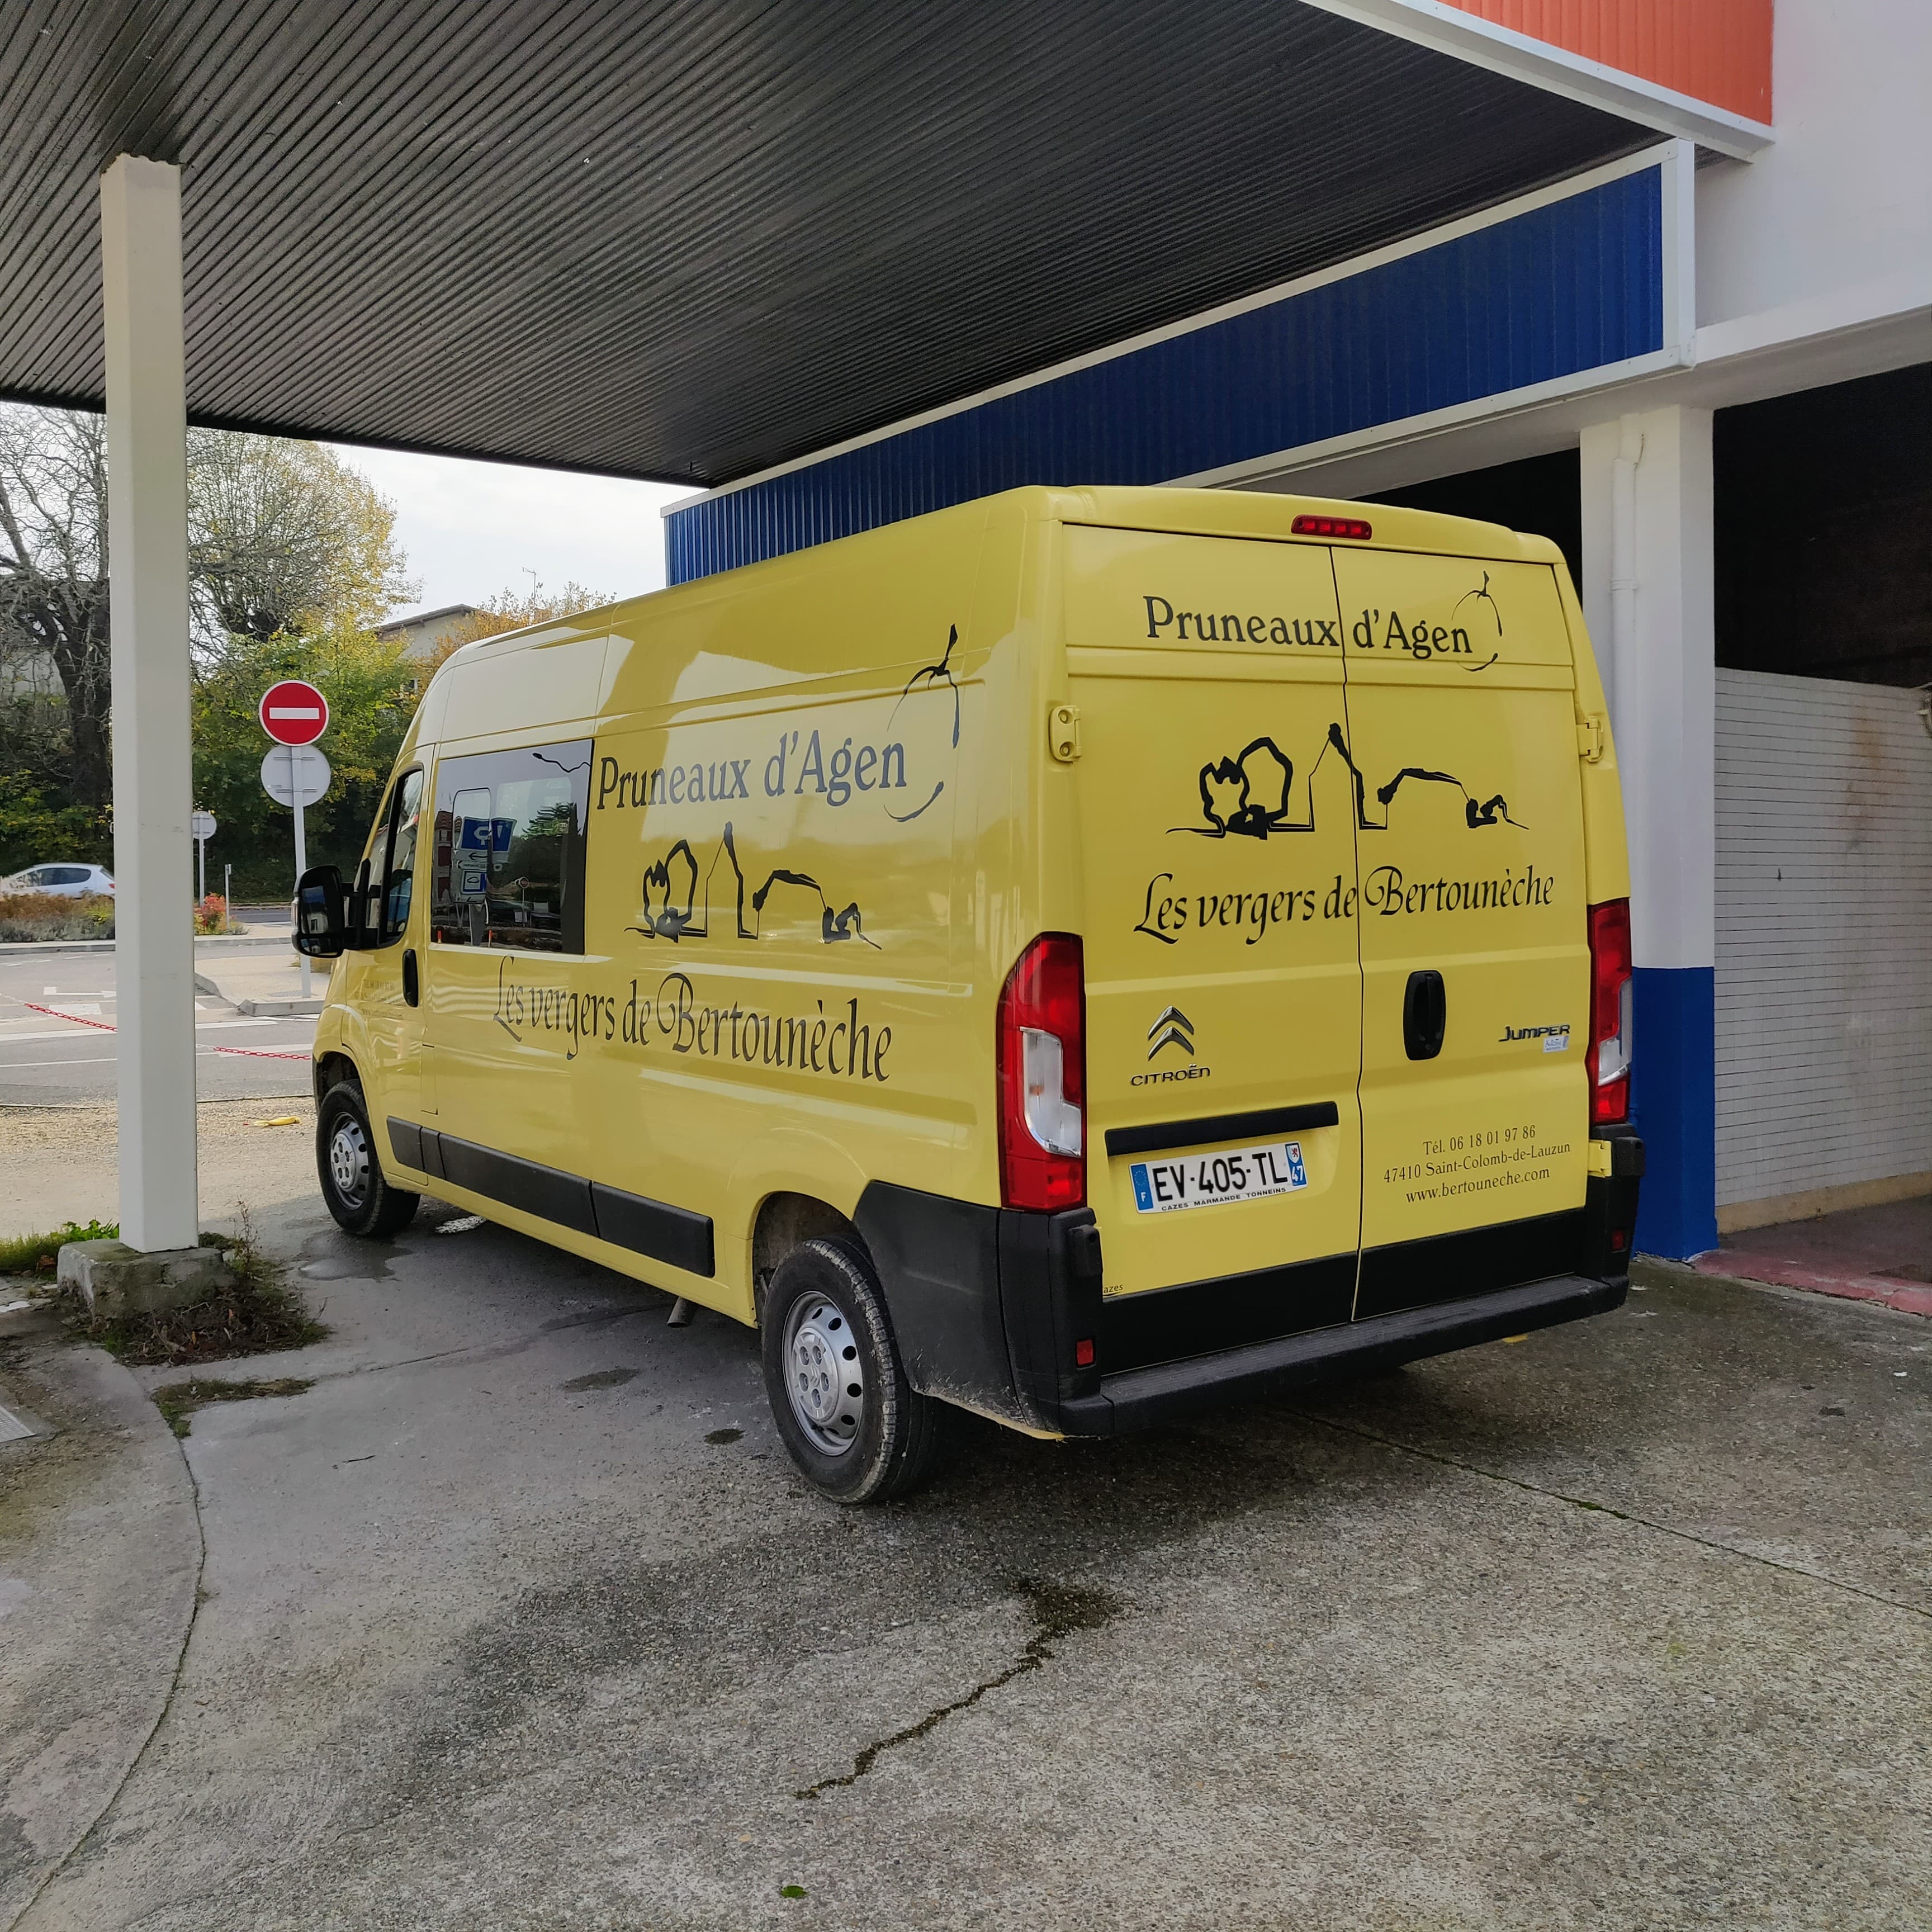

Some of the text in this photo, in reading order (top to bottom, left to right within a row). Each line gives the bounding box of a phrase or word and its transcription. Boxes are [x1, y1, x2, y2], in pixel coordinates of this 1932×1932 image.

[1143, 595, 1472, 660] Pruneaux d'Agen
[596, 729, 907, 810] Pruneaux d'Agen
[1133, 865, 1554, 945] Les vergers de Bertounèche
[493, 954, 892, 1082] Les vergers de Bertounèche
[1423, 1124, 1536, 1155] Tél. 06 18 01 97 86
[1152, 1152, 1288, 1202] EV-405-TL
[1291, 1165, 1304, 1182] 47
[1384, 1143, 1570, 1183] 47410 Saint-Colomb-de-Lauzun
[1140, 1191, 1147, 1202] F
[1162, 1187, 1286, 1211] CAZES MARMANDE TONNEINS
[1406, 1168, 1550, 1202] www.bertouneche.com
[1104, 1284, 1123, 1294] azes
